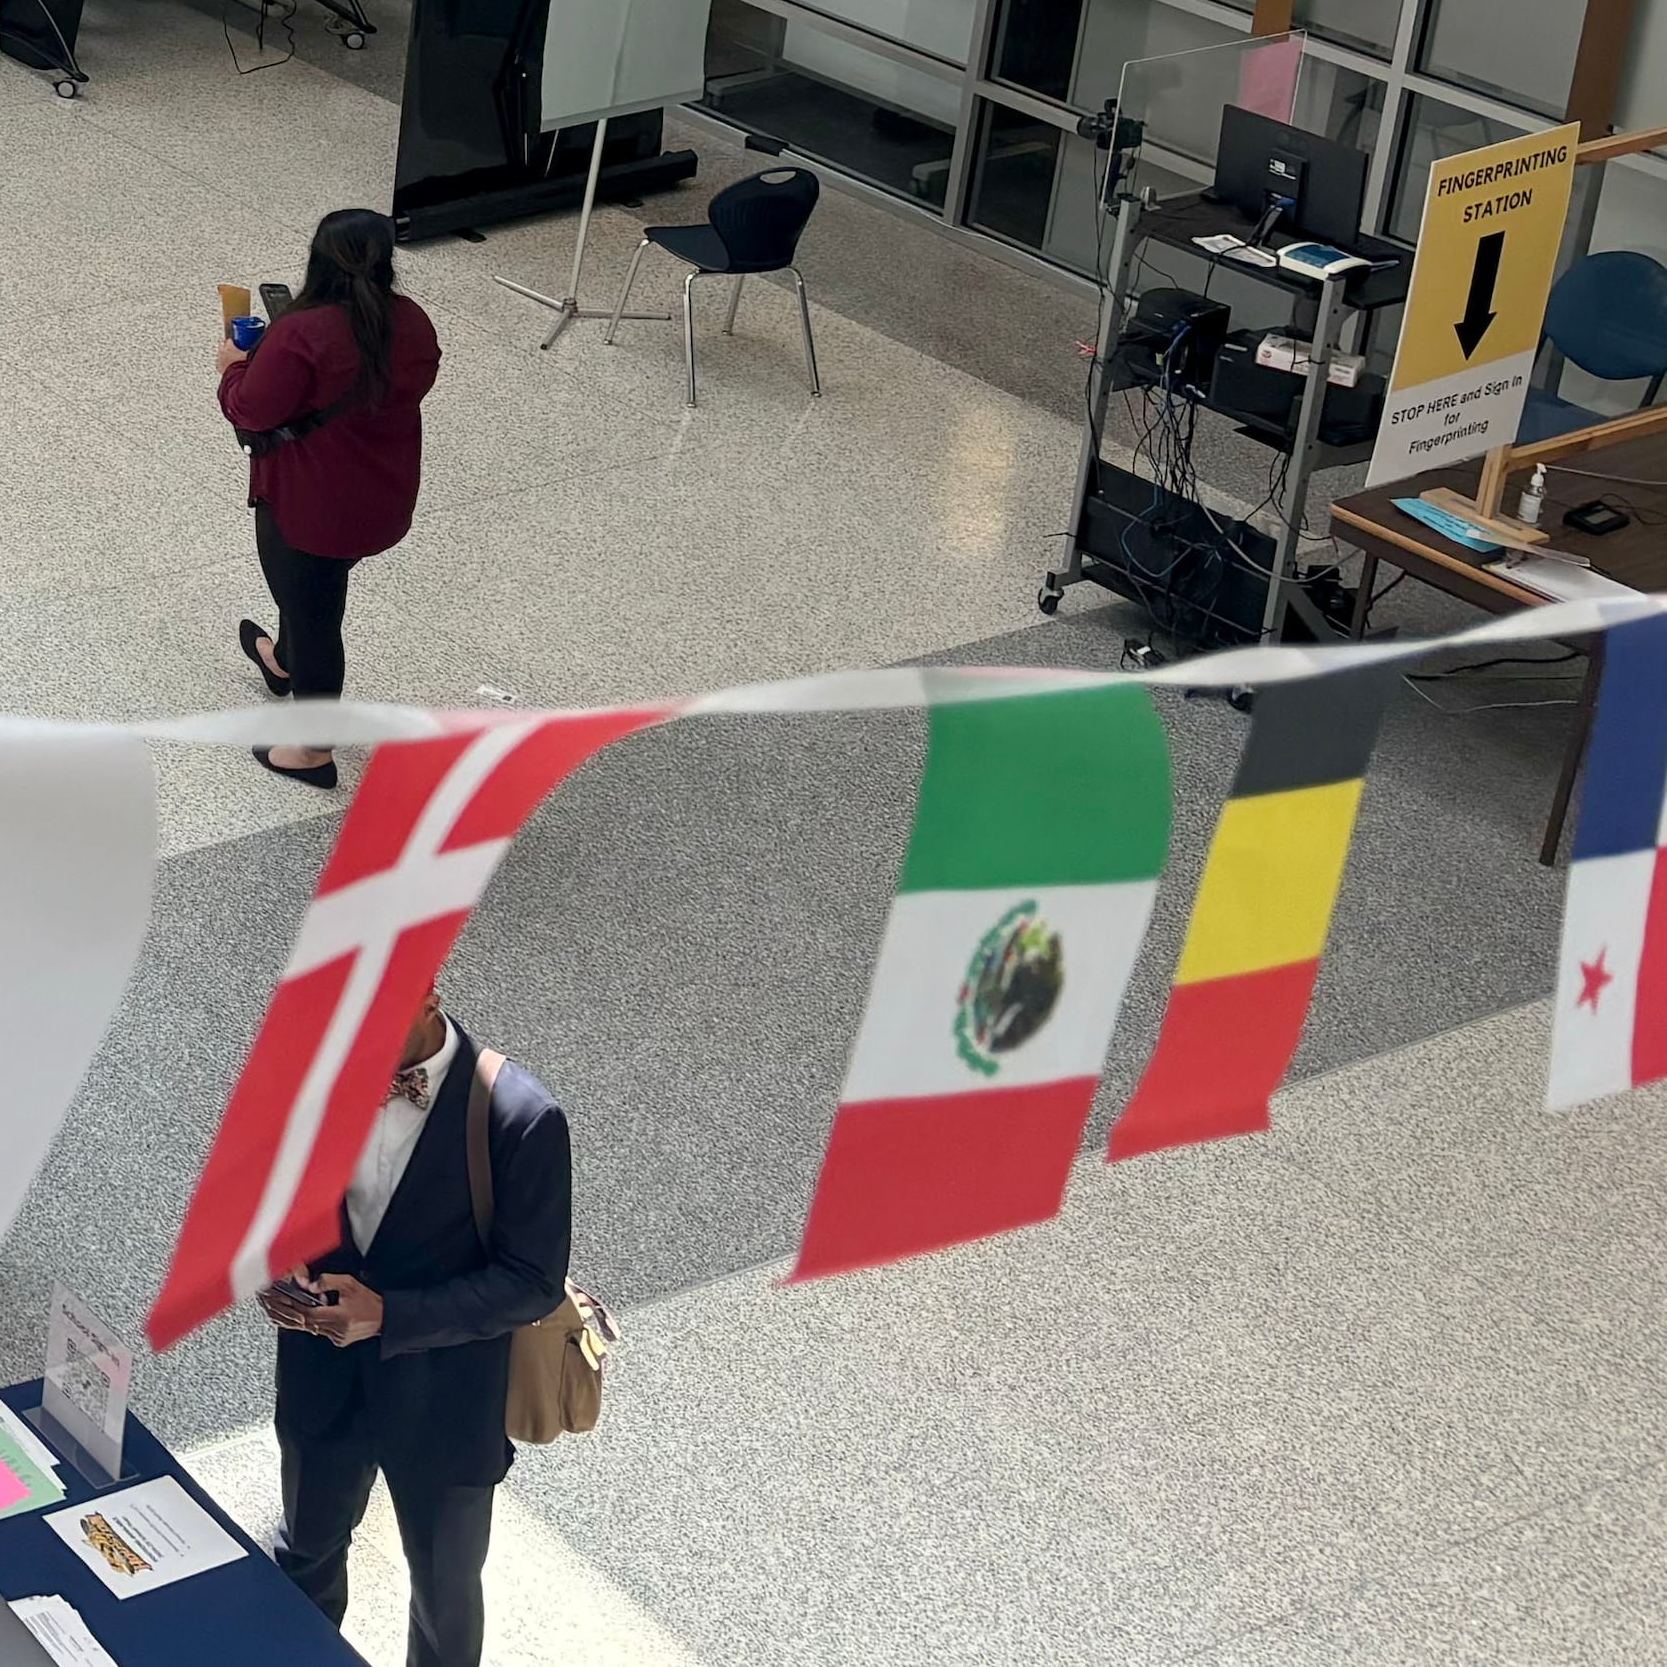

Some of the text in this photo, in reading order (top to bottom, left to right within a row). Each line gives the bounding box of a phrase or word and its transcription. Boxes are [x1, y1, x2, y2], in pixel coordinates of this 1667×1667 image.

[1437, 145, 1567, 197] FINGERPRINTING
[1463, 189, 1533, 223] STATION
[1391, 404, 1425, 425] STOP
[1426, 393, 1458, 415] HERE
[1460, 385, 1483, 403] and
[1484, 379, 1509, 397] Sign
[1443, 411, 1461, 426] for
[1408, 420, 1489, 454] Fingerprinting
